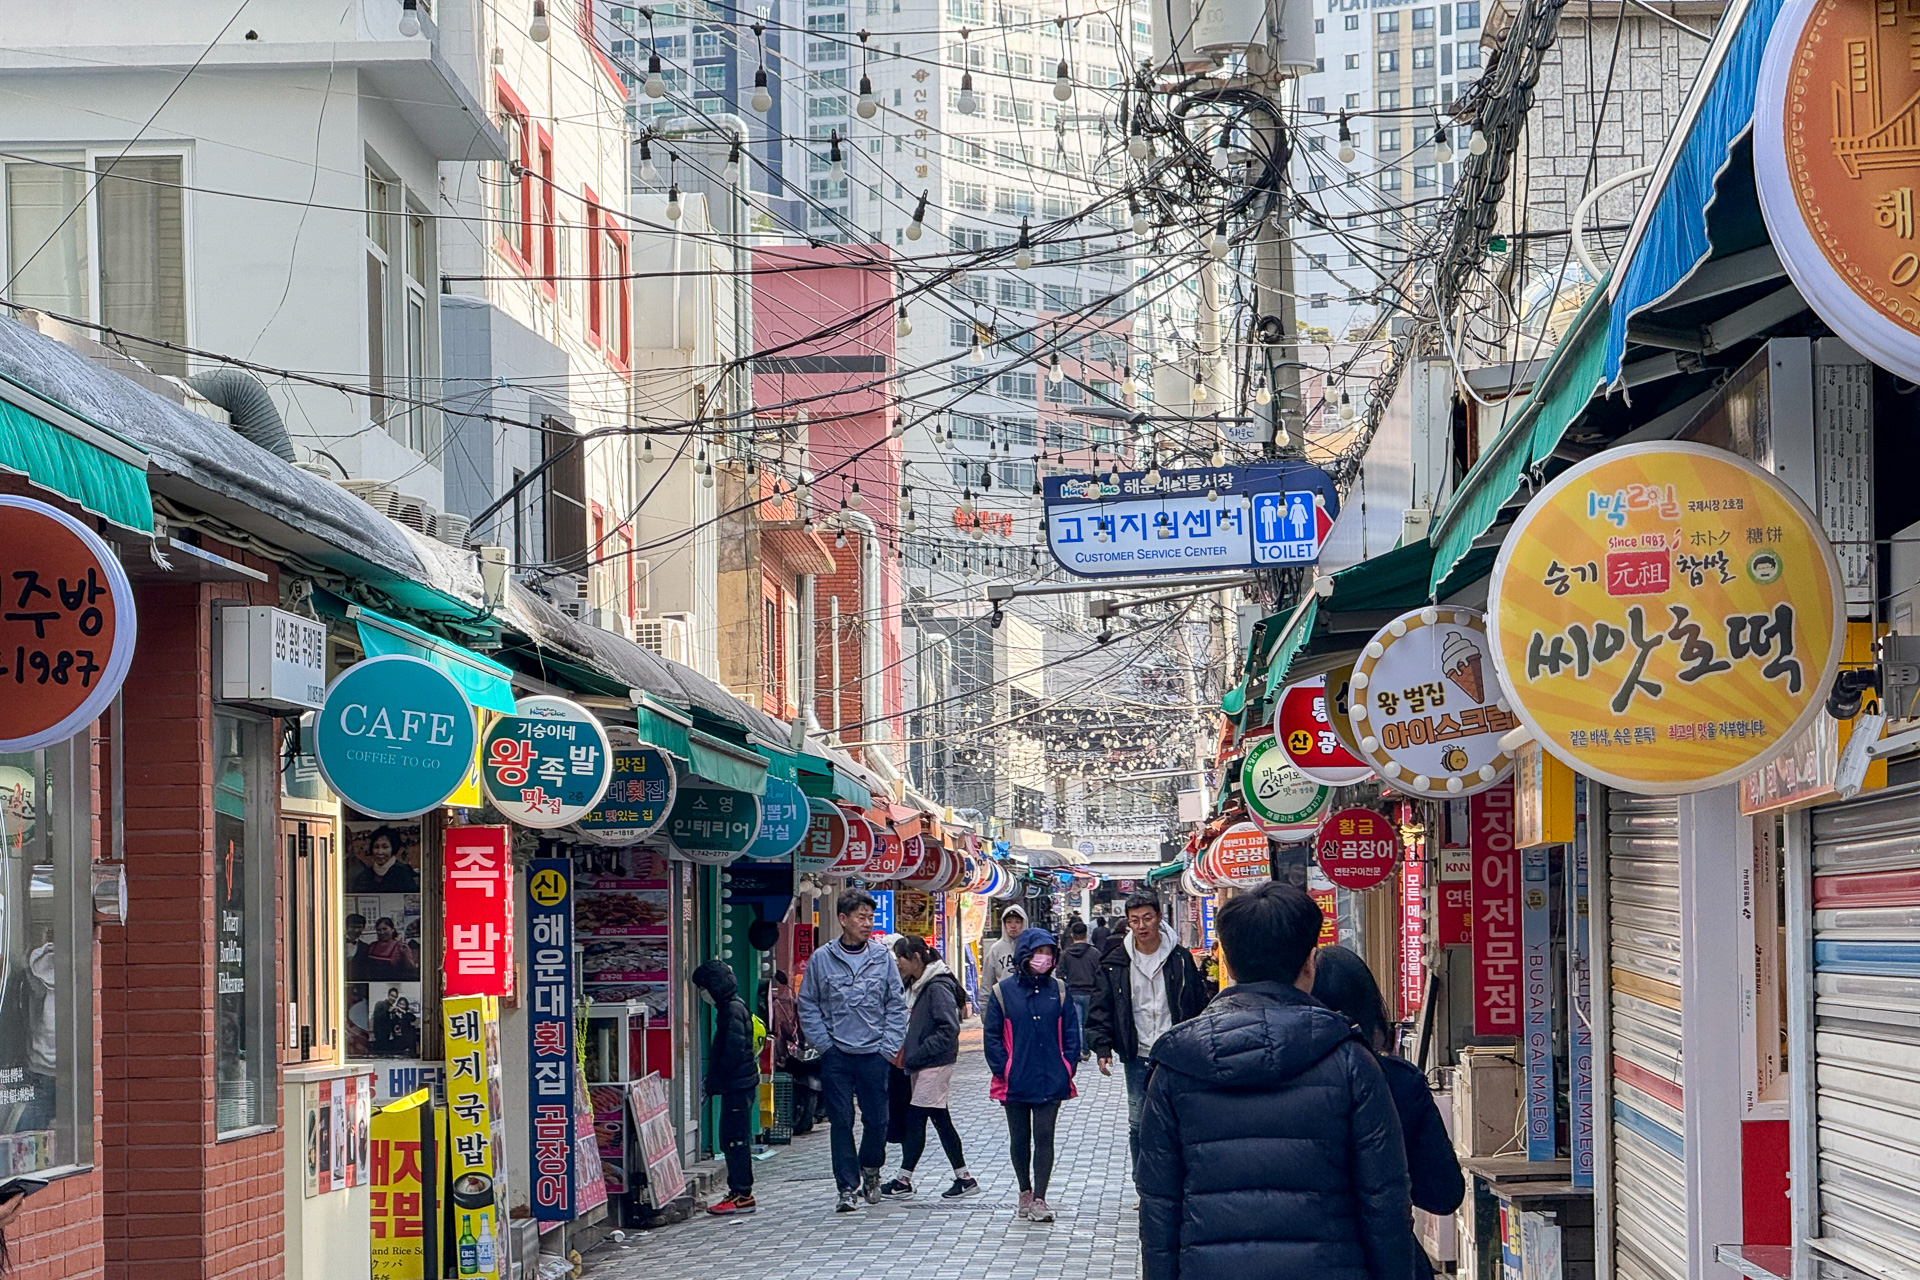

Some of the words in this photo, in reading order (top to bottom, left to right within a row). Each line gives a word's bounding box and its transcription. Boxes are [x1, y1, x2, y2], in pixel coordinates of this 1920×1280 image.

[1688, 499, 1719, 512] 국제시장
[1723, 498, 1744, 510] 2호점
[1058, 508, 1242, 544] 고객지원센터
[1641, 534, 1666, 547] 1983
[1075, 550, 1134, 563] CUSTOMER
[1137, 548, 1181, 560] SERVICE
[1184, 546, 1227, 557] CENTER
[1260, 544, 1313, 560] TOILET
[1545, 561, 1598, 595] 승기
[1612, 561, 1667, 588] 元祖
[1676, 550, 1736, 587] 찹쌀
[1527, 604, 1802, 712] 씨앗호떡
[1377, 691, 1399, 716] 왕
[1403, 681, 1445, 714] 벌집
[339, 703, 455, 748] CAFE
[517, 722, 576, 741] 기승이네
[1570, 731, 1587, 746] 겉은
[1613, 729, 1632, 743] 속은
[1669, 724, 1695, 740] 최고의
[1697, 722, 1716, 738] 맛을
[346, 748, 396, 765] COFFEE
[400, 755, 419, 769] TO
[422, 757, 440, 770] GO
[520, 786, 563, 815] 맛집
[605, 809, 639, 822] 맛있는
[642, 809, 653, 821] 집
[674, 819, 750, 840] 인테리어
[534, 873, 560, 902] 신
[449, 845, 500, 976] 족발
[1407, 935, 1422, 1004] 포장됩니다
[532, 914, 567, 1096] 해운대횟집
[1529, 954, 1544, 1025] BUSAN
[447, 1009, 490, 1167] 돼지국밥
[1531, 1032, 1549, 1141] GALMAEGI
[1577, 1055, 1594, 1175] GALMAEGI
[534, 1104, 569, 1211] 곰장어
[392, 1246, 412, 1256] Rice
